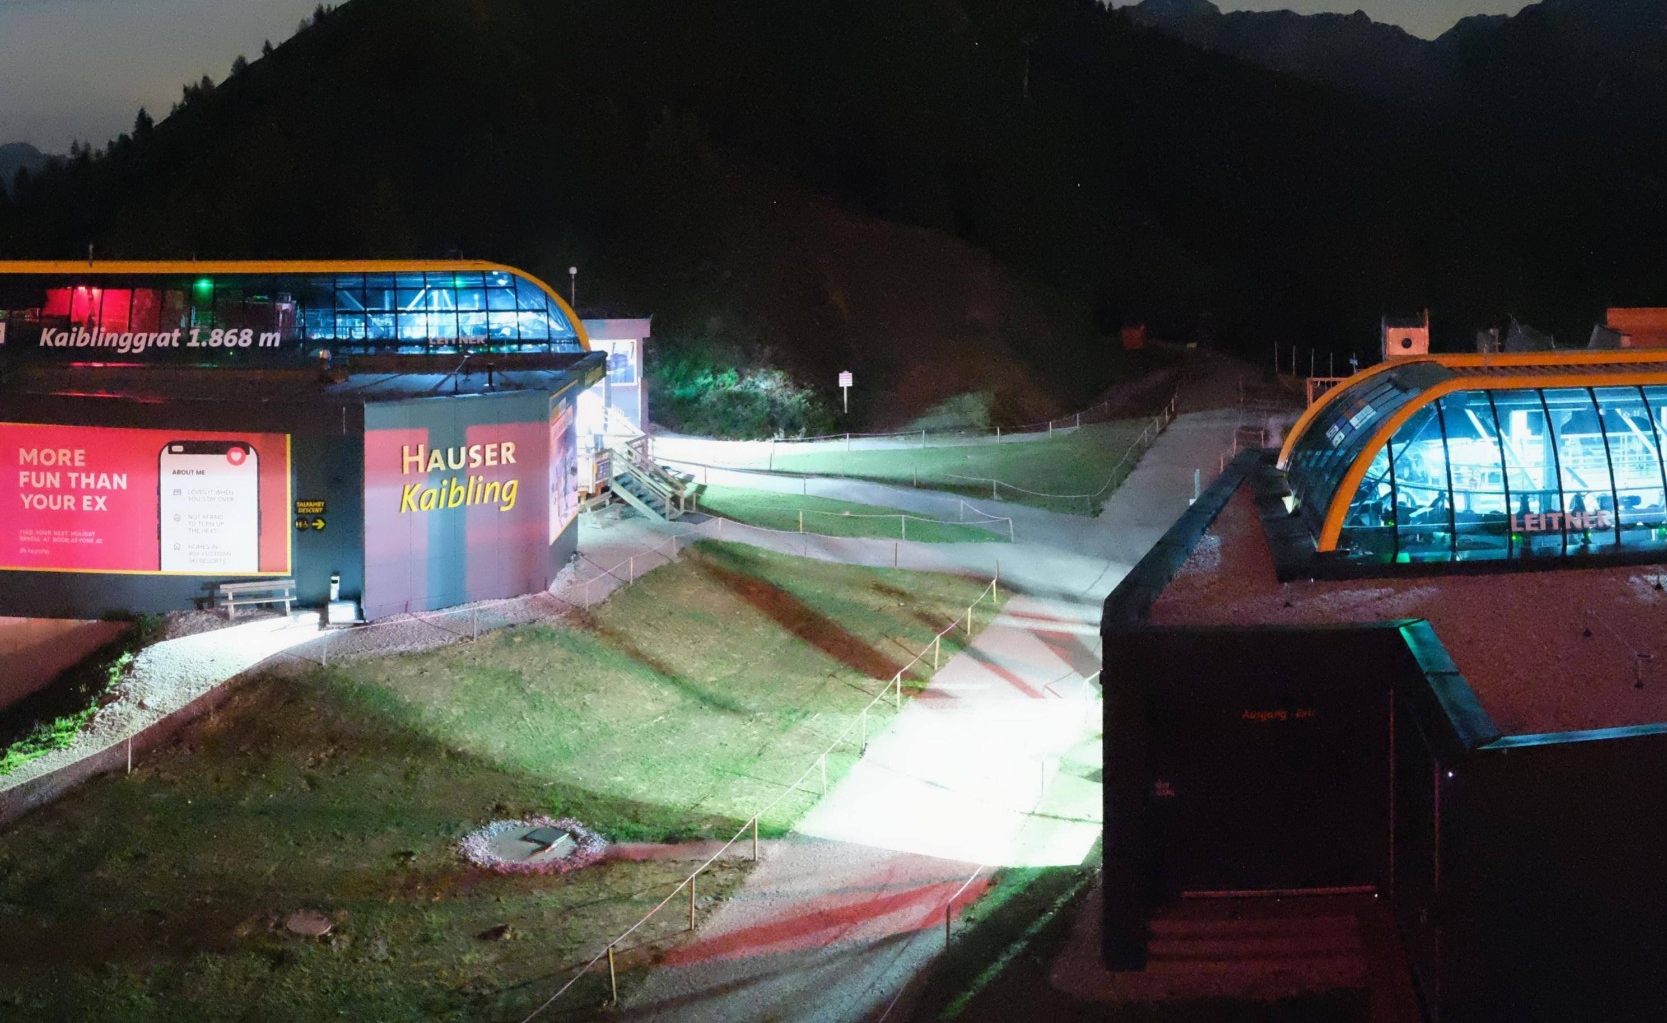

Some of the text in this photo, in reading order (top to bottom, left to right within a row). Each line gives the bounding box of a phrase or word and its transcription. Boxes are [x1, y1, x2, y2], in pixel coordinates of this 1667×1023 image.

[39, 327, 281, 353] Kaiblinggrat 1.868 m
[429, 336, 486, 346] LEITNER
[18, 448, 86, 467] MORE
[401, 441, 518, 474] HAUSER
[19, 471, 128, 490] FUN THAN
[20, 494, 108, 512] YOUR EX
[400, 476, 519, 514] Kaibling
[1511, 510, 1612, 532] LEITNER
